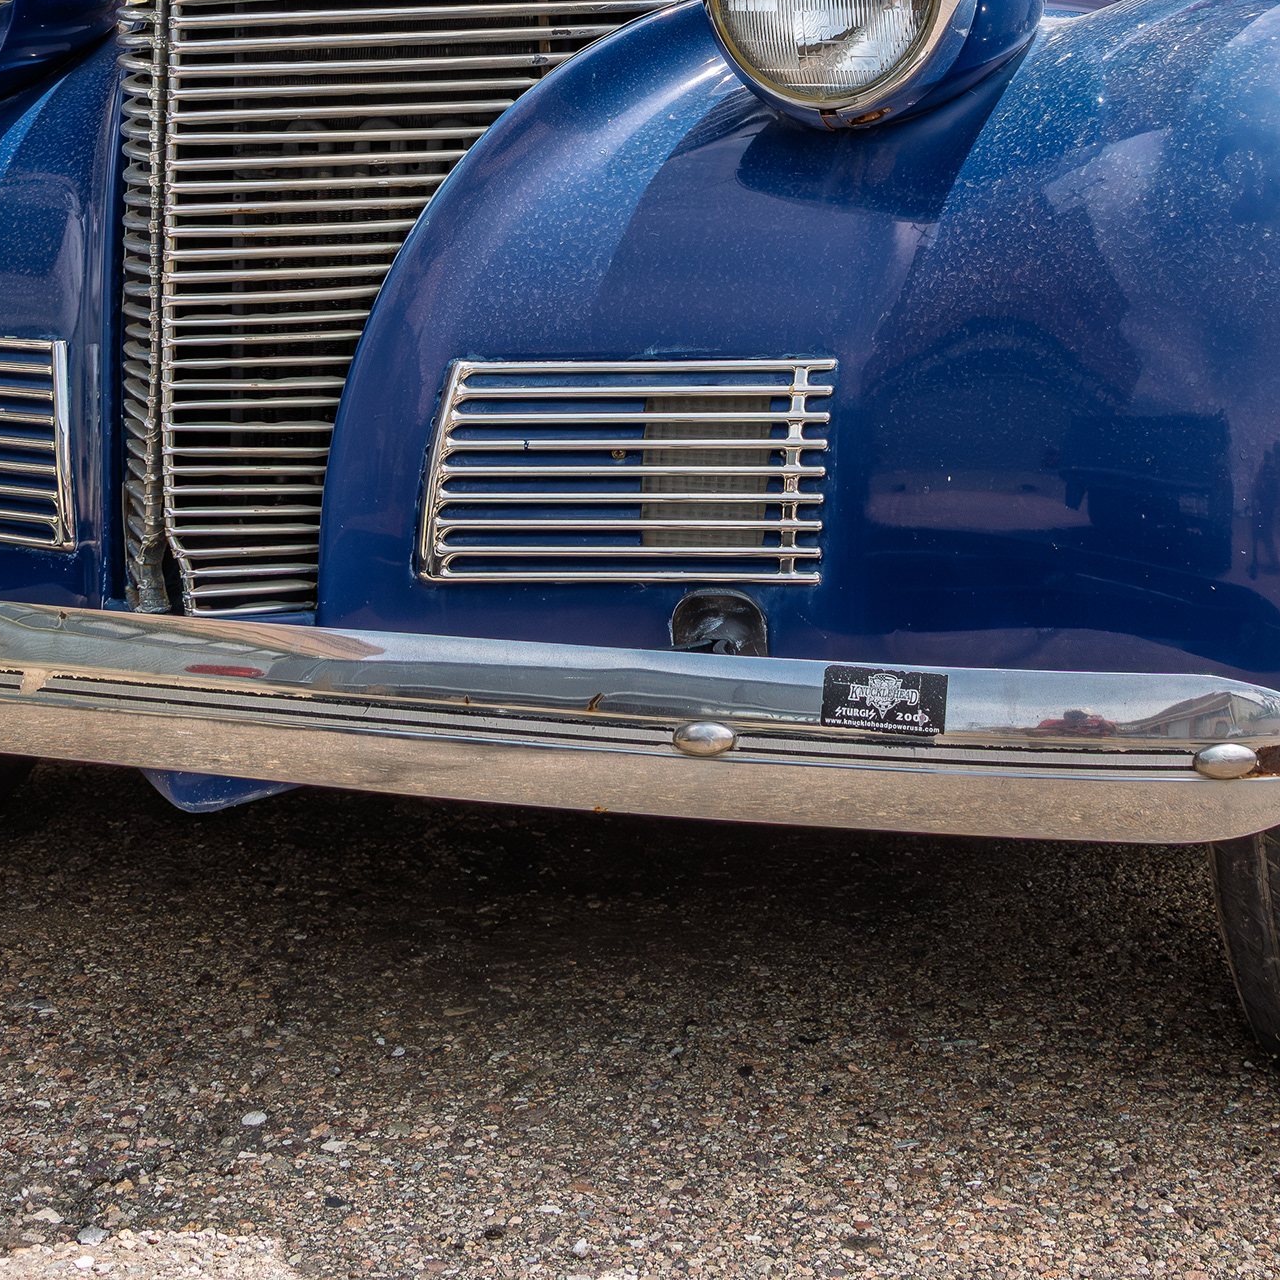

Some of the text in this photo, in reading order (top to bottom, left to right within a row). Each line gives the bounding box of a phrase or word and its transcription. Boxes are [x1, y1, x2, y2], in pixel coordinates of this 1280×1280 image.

[848, 683, 919, 706] KNUCKLEHEAD
[835, 706, 876, 719] STURGIS
[825, 717, 940, 733] www.knuckleheadpowerusa.com
